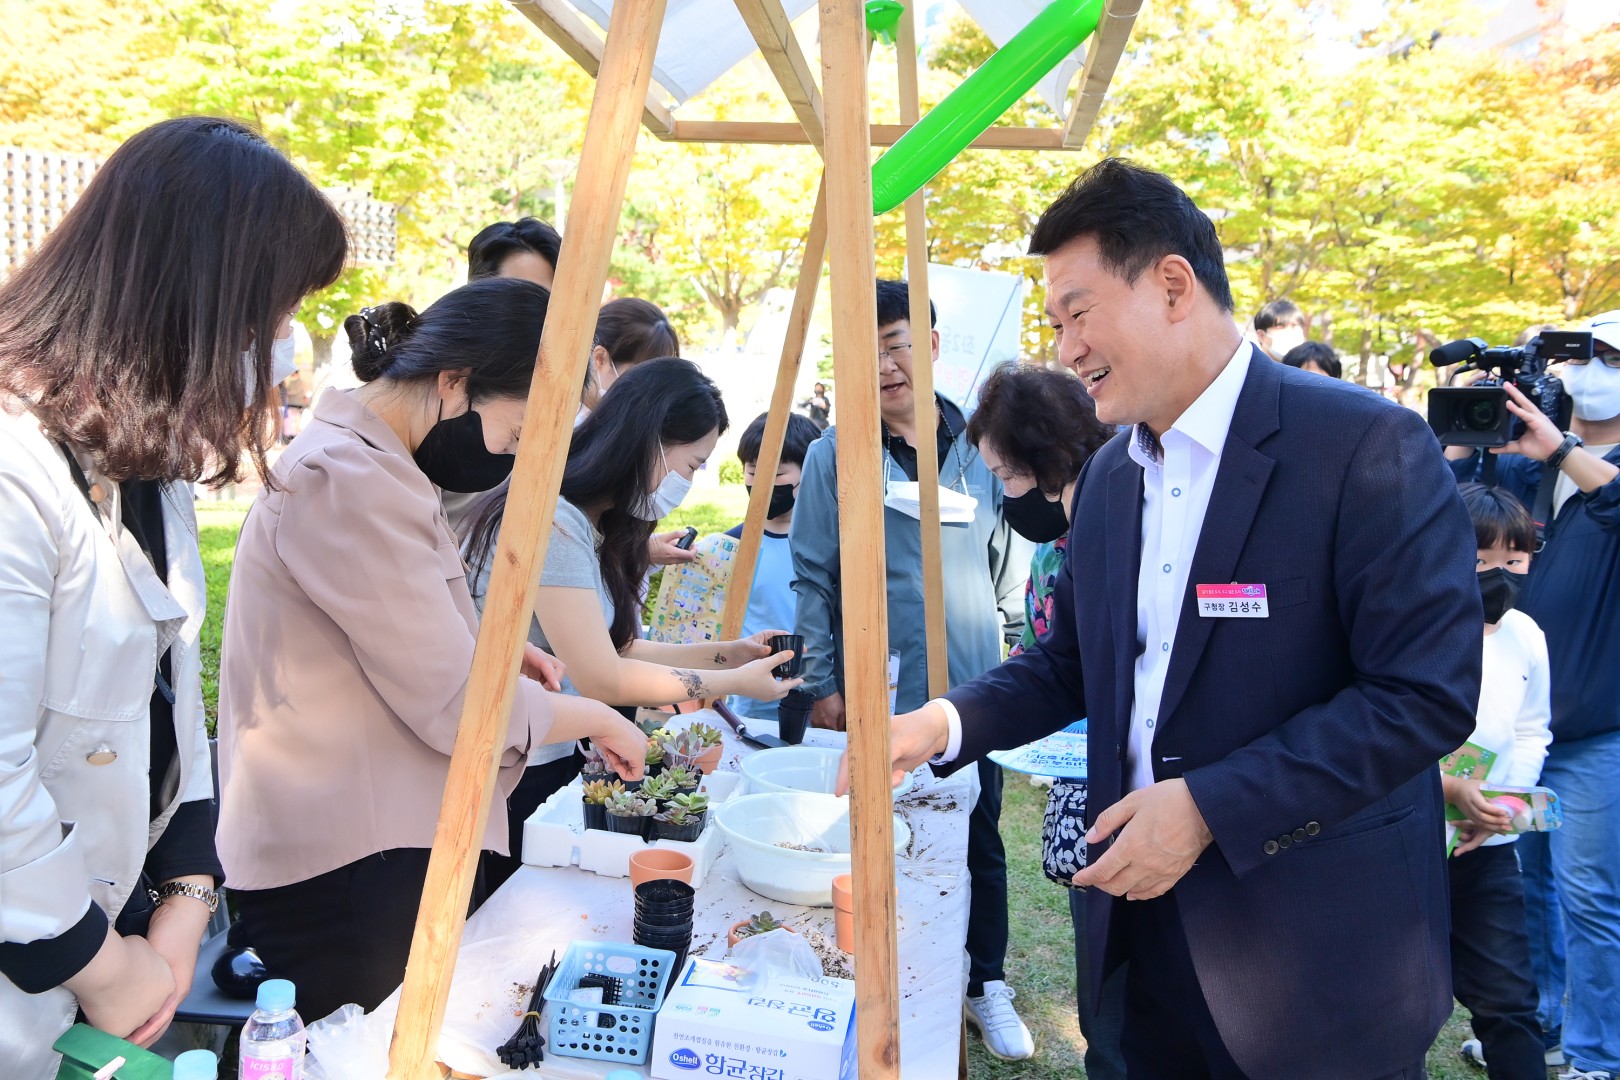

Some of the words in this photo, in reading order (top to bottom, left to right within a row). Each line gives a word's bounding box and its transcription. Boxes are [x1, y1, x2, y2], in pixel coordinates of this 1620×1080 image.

[1203, 602, 1225, 612] 구청장
[1228, 601, 1262, 613] 김성수
[747, 996, 837, 1023] 항균장갑
[672, 1053, 698, 1065] Oshell
